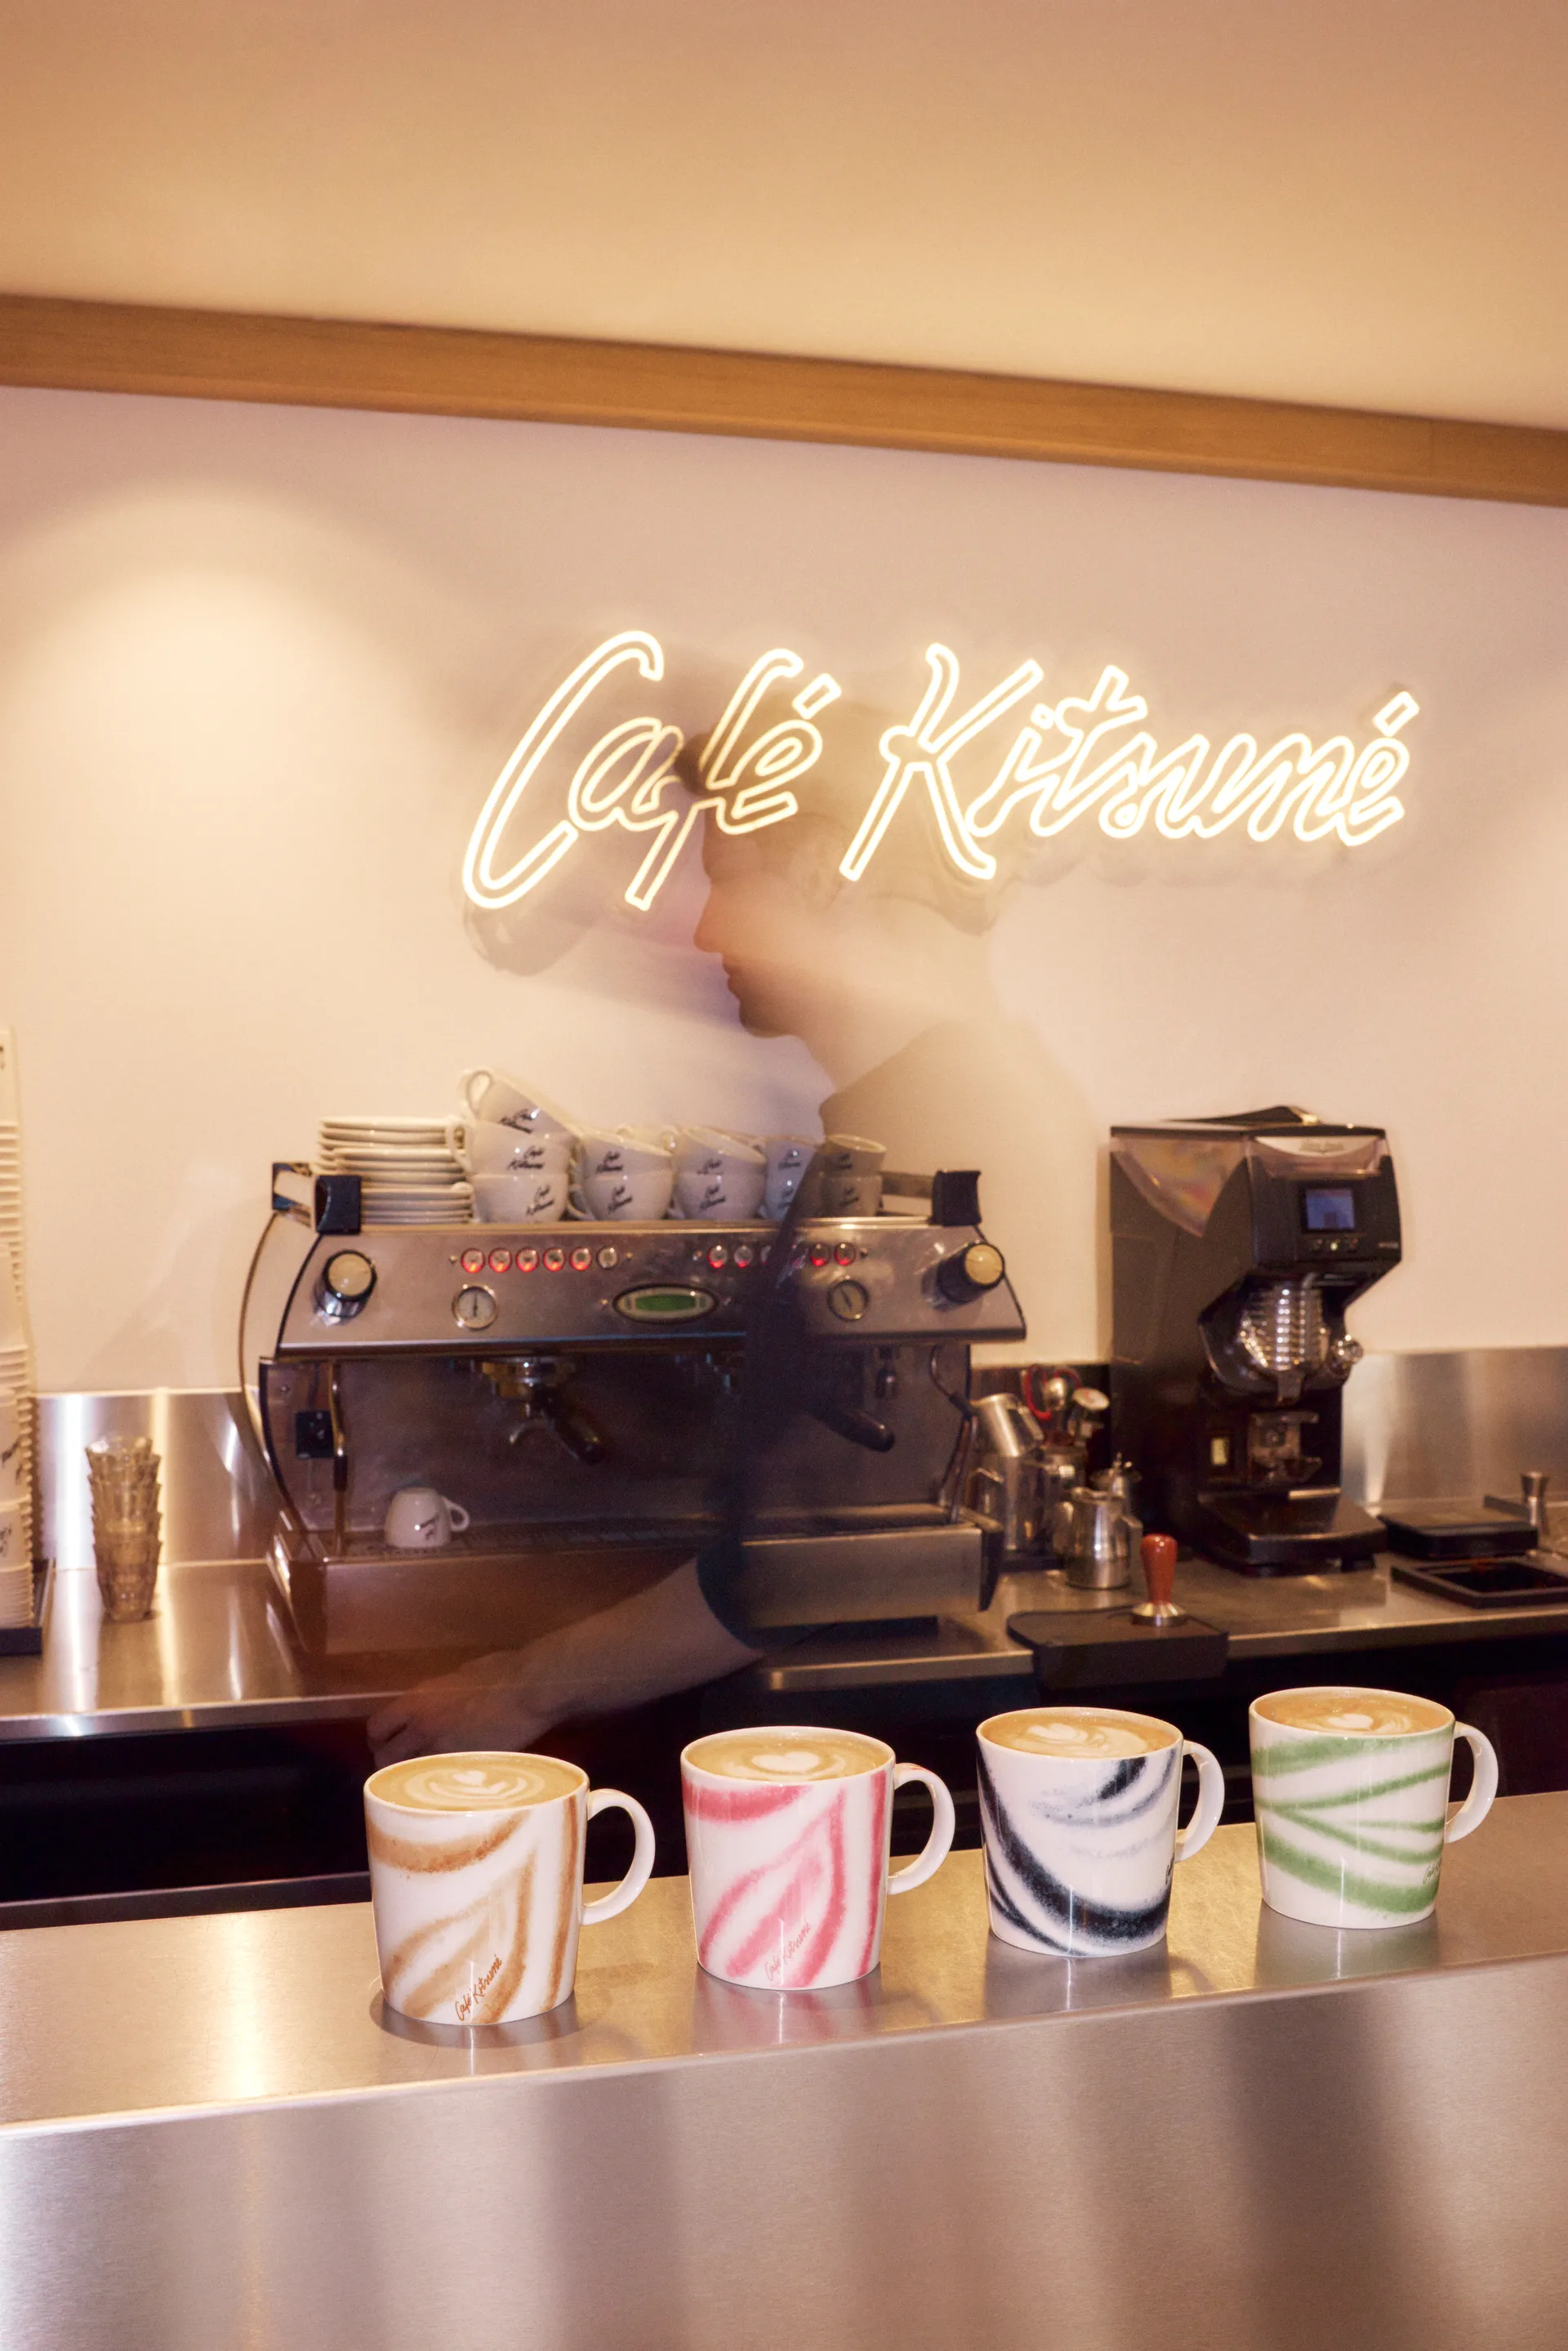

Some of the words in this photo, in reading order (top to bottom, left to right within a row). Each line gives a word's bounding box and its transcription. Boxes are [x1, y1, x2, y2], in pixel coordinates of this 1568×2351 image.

[463, 631, 842, 911] Café
[839, 642, 1419, 882] Kitsuné
[455, 1988, 471, 2021] Café
